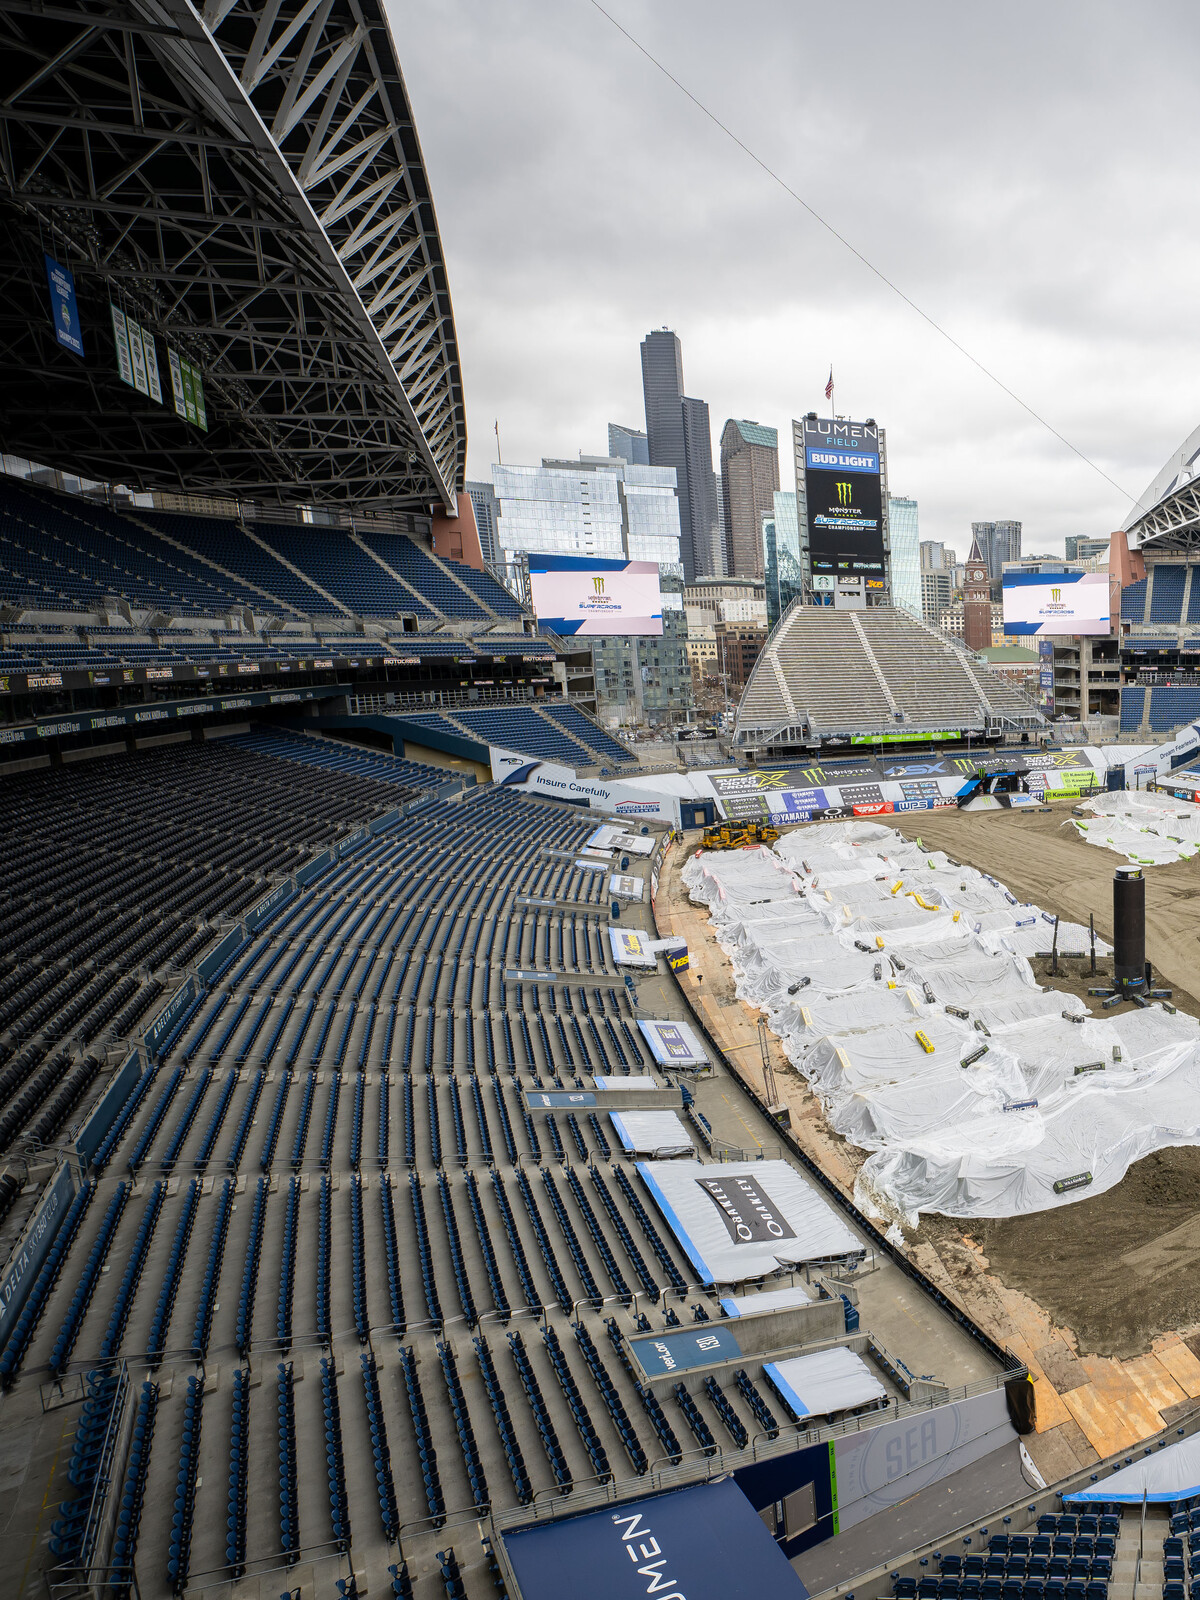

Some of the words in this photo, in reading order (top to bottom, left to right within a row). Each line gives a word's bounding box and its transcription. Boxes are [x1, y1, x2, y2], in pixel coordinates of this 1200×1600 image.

[805, 421, 878, 439] LUMEN
[826, 437, 858, 448] FIELD
[811, 453, 838, 465] BUD
[839, 455, 874, 468] LIGHT
[829, 507, 862, 515] MONSTER
[815, 518, 877, 527] SUPERCROSS
[146, 671, 173, 679] MOTOCROSS
[28, 677, 63, 688] MOTOCROSS
[1160, 746, 1176, 760] Dream
[1175, 736, 1198, 754] Fearlessly
[824, 768, 874, 776] MONSTER
[536, 775, 567, 790] Insure
[568, 782, 611, 800] Carefully
[854, 805, 884, 813] FLY
[899, 800, 929, 812] WPS
[780, 812, 810, 822] YAMAHA
[735, 1179, 773, 1220] OAKLEY
[654, 1342, 677, 1370] verizon
[885, 1417, 938, 1480] SEA
